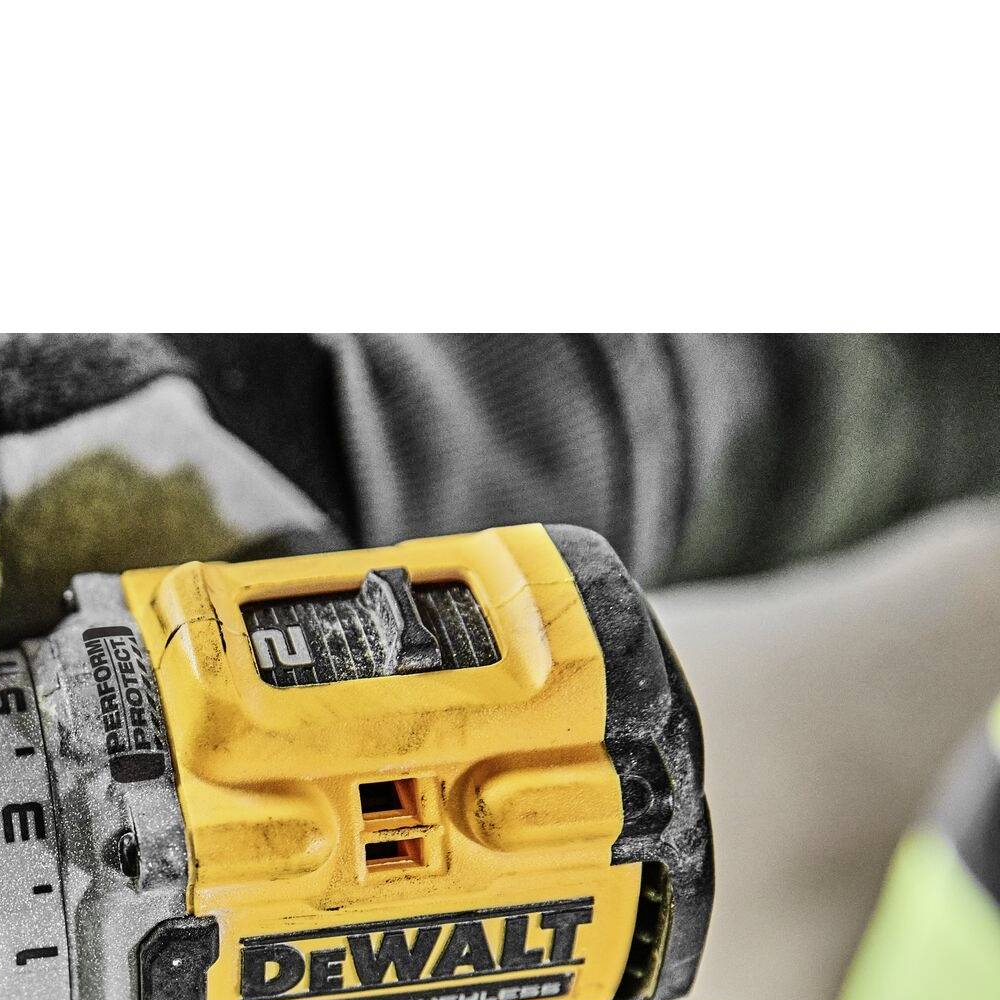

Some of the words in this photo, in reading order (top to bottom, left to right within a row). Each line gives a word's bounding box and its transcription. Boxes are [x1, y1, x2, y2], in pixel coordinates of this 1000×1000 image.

[251, 625, 313, 670] 2
[84, 638, 126, 755] PERFORM
[1, 801, 46, 844] 3
[15, 945, 59, 966] 1
